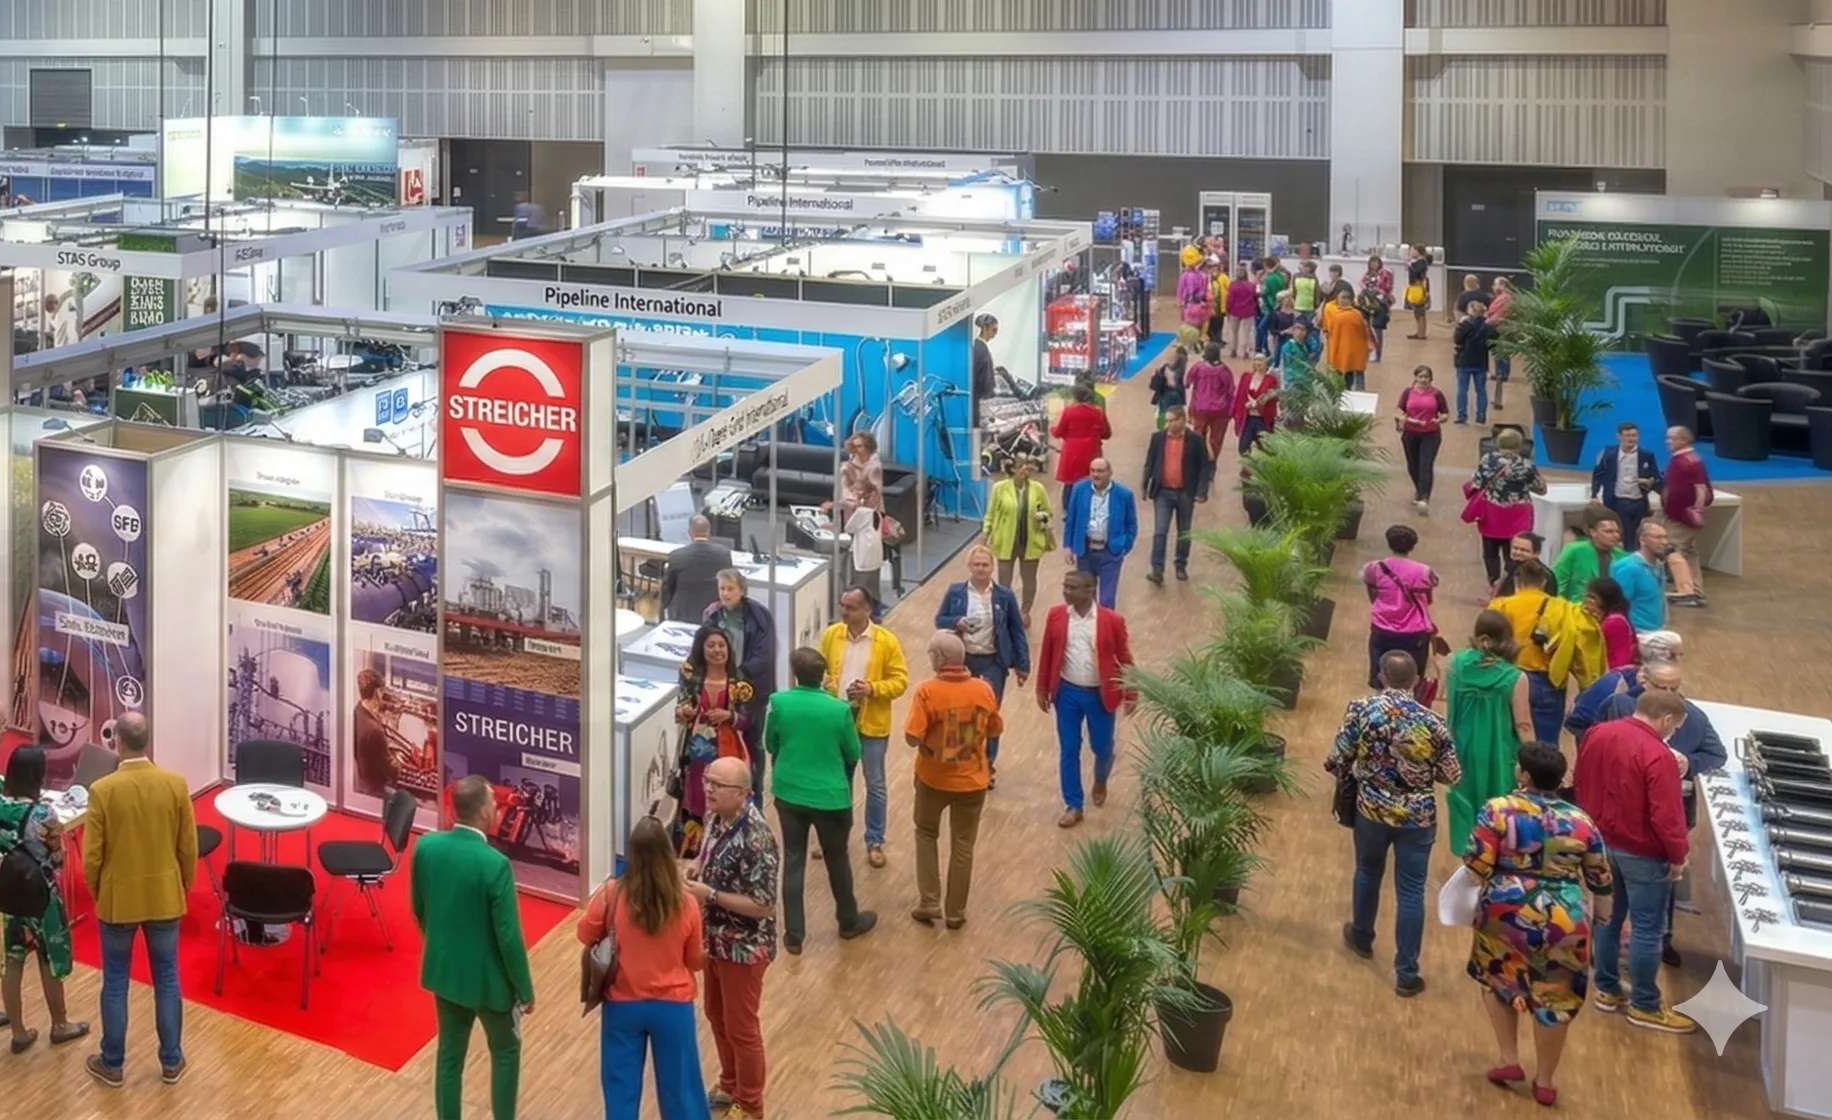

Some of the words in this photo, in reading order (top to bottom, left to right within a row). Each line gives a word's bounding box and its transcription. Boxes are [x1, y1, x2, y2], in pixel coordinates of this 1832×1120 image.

[57, 251, 86, 267] STAS
[88, 252, 121, 271] Group
[545, 287, 610, 308] Pipeline
[615, 293, 723, 318] International
[449, 394, 577, 433] STREICHER
[455, 711, 574, 755] STREICHER
